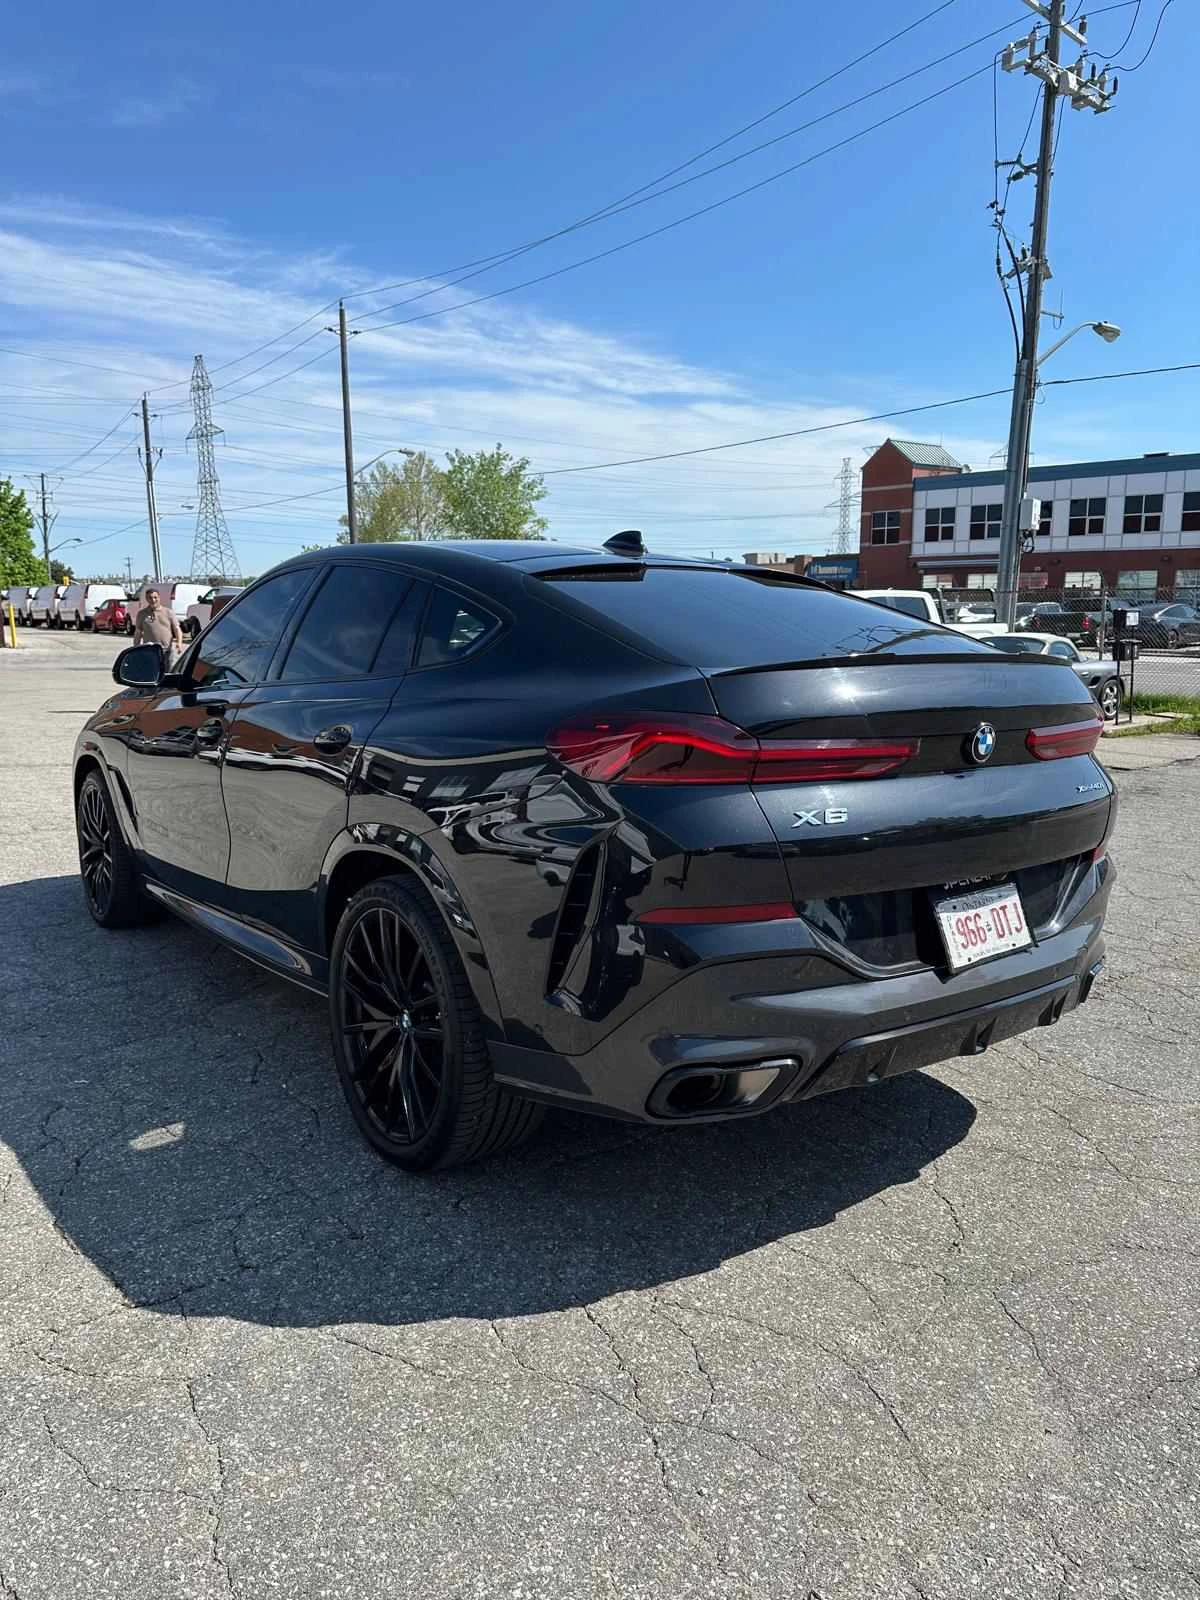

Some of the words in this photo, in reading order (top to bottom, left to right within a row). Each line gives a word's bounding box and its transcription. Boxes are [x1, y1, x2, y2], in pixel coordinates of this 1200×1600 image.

[791, 808, 848, 828] X6
[955, 912, 988, 949] 966
[990, 902, 1023, 939] DTJ
